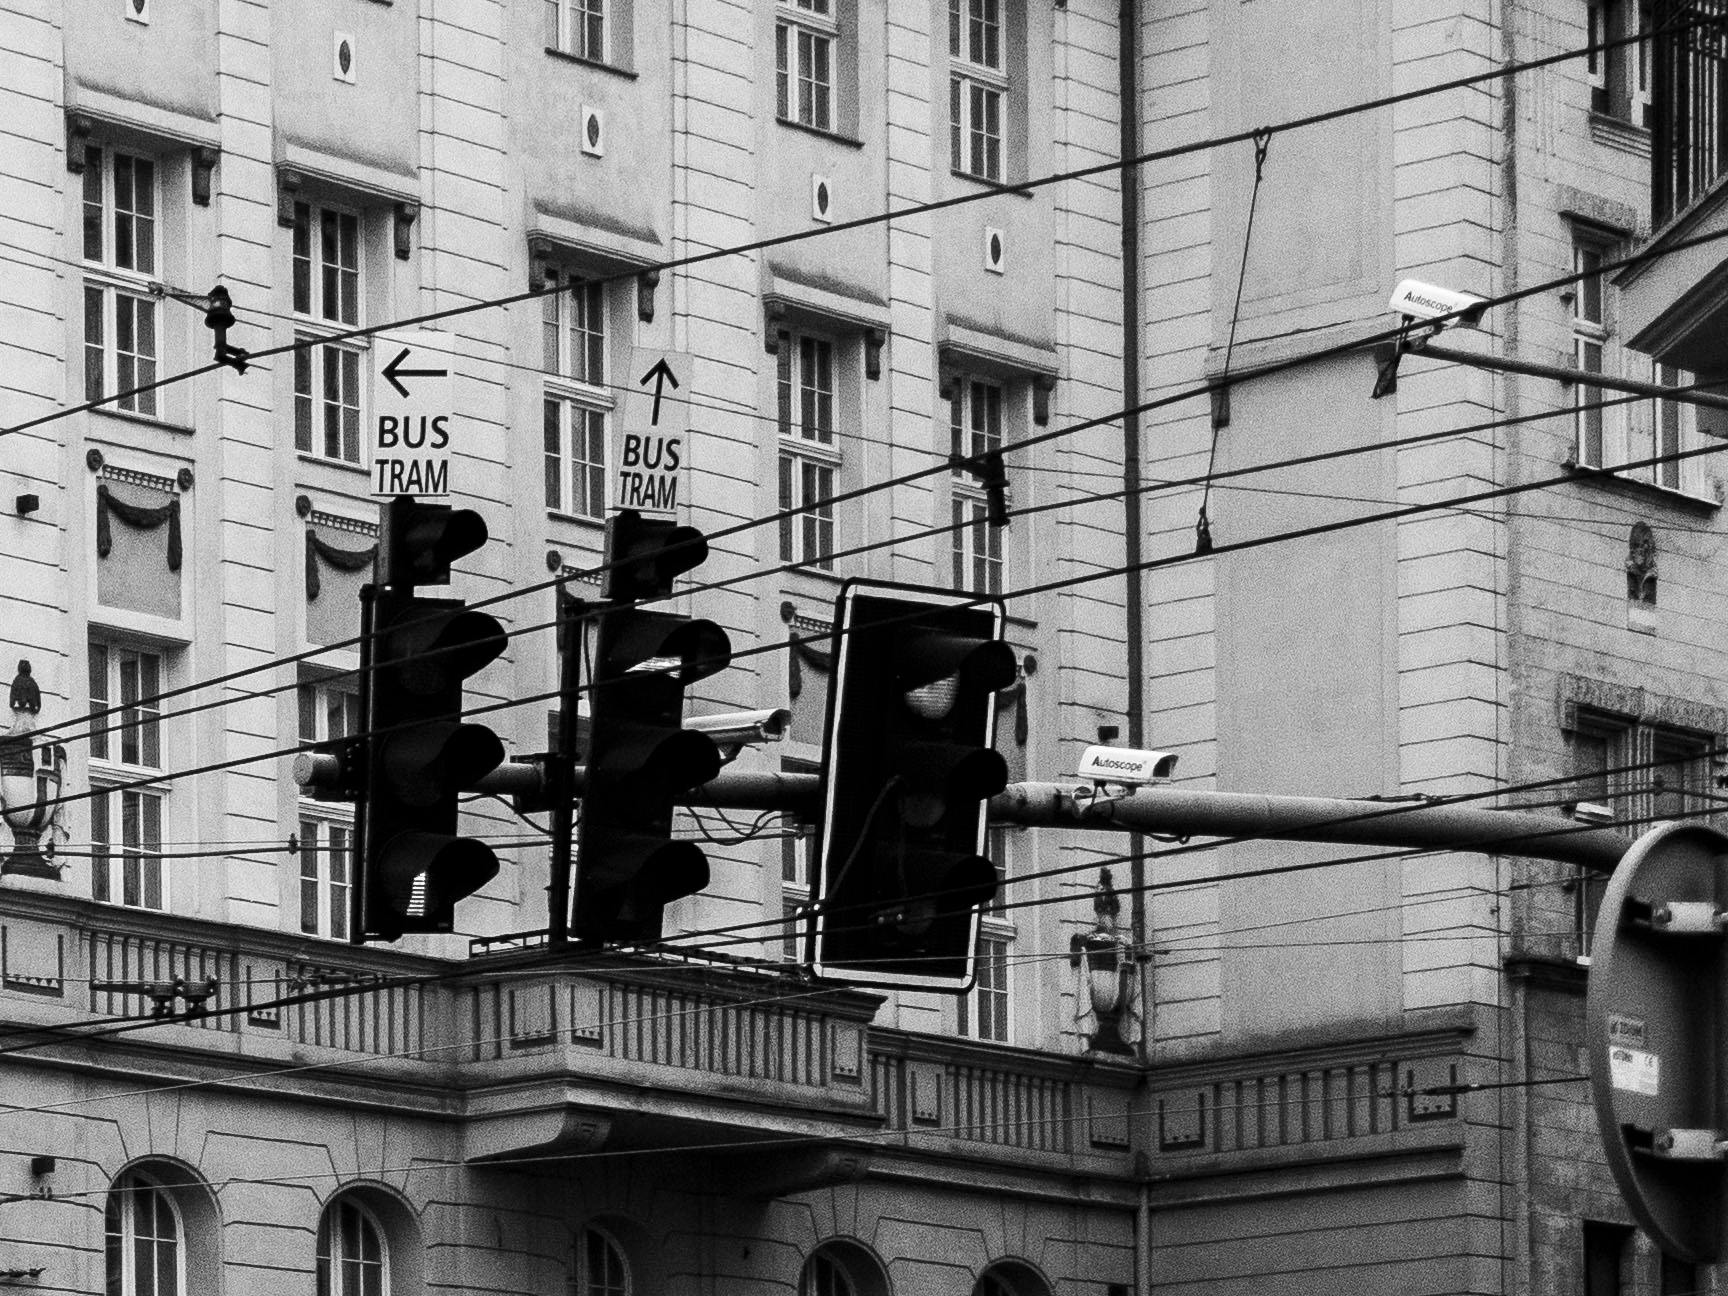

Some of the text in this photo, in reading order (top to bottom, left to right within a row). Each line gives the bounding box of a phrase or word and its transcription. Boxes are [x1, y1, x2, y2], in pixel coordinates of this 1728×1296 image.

[378, 415, 449, 449] BUS
[623, 434, 681, 472] BUS
[375, 459, 449, 493] TRAM
[619, 471, 678, 510] TRAM
